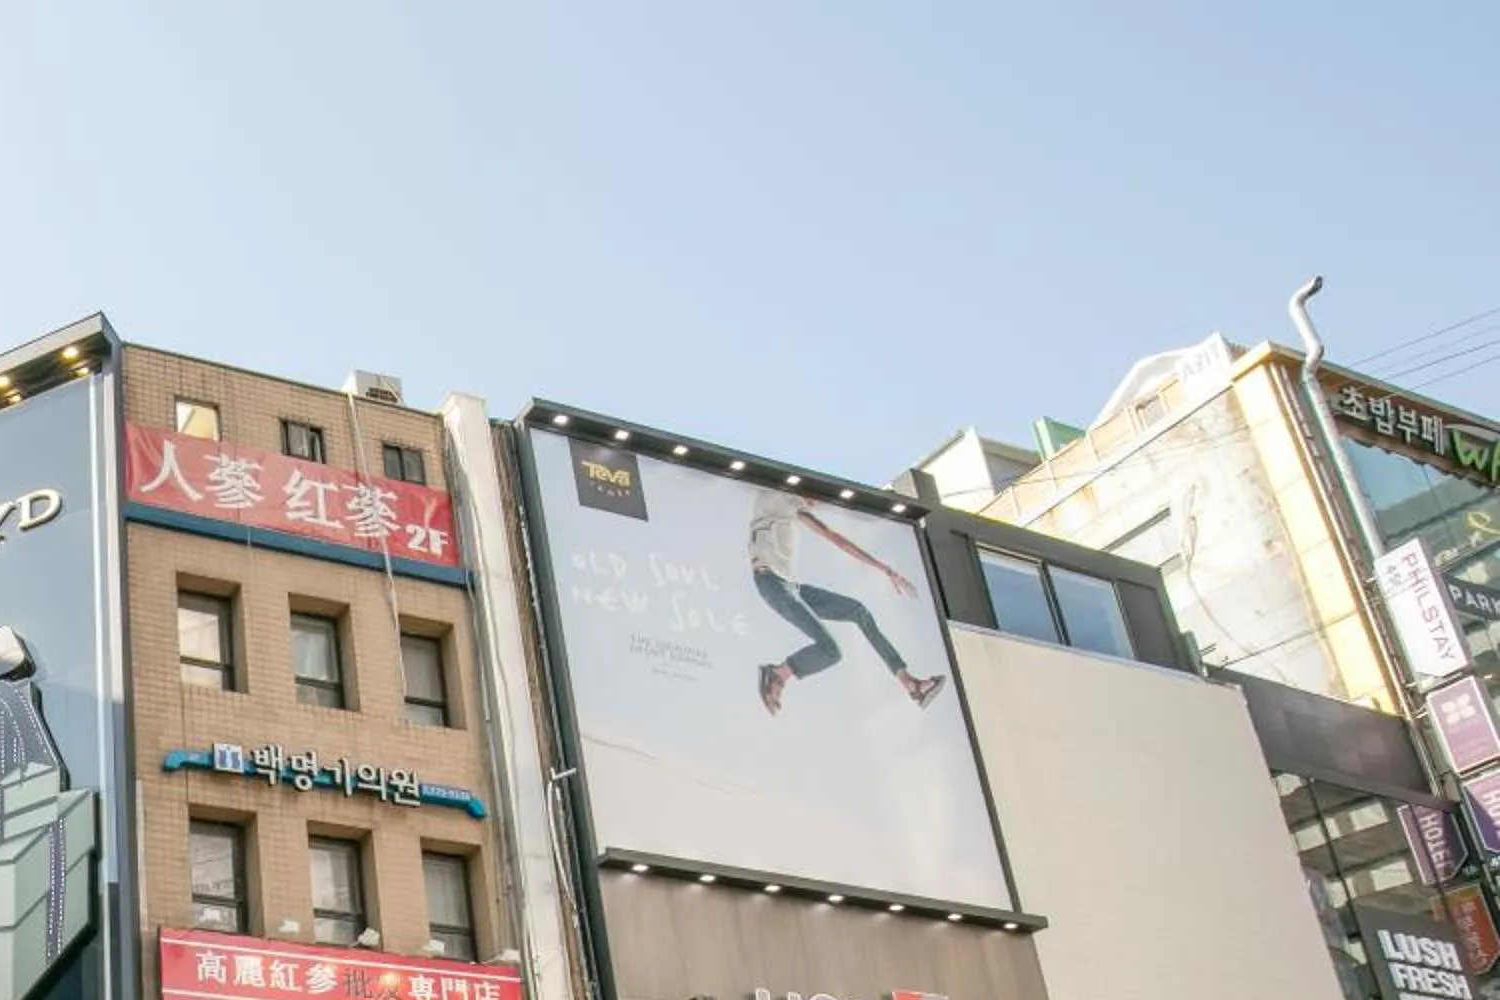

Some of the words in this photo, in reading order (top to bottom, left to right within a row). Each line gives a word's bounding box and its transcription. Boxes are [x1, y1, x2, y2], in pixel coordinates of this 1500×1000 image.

[406, 522, 449, 556] 2F
[1401, 551, 1456, 660] PHILSTAY
[252, 743, 422, 807] 백명기의원
[1377, 929, 1462, 971] LUSH
[1388, 962, 1473, 1000] FRESH
